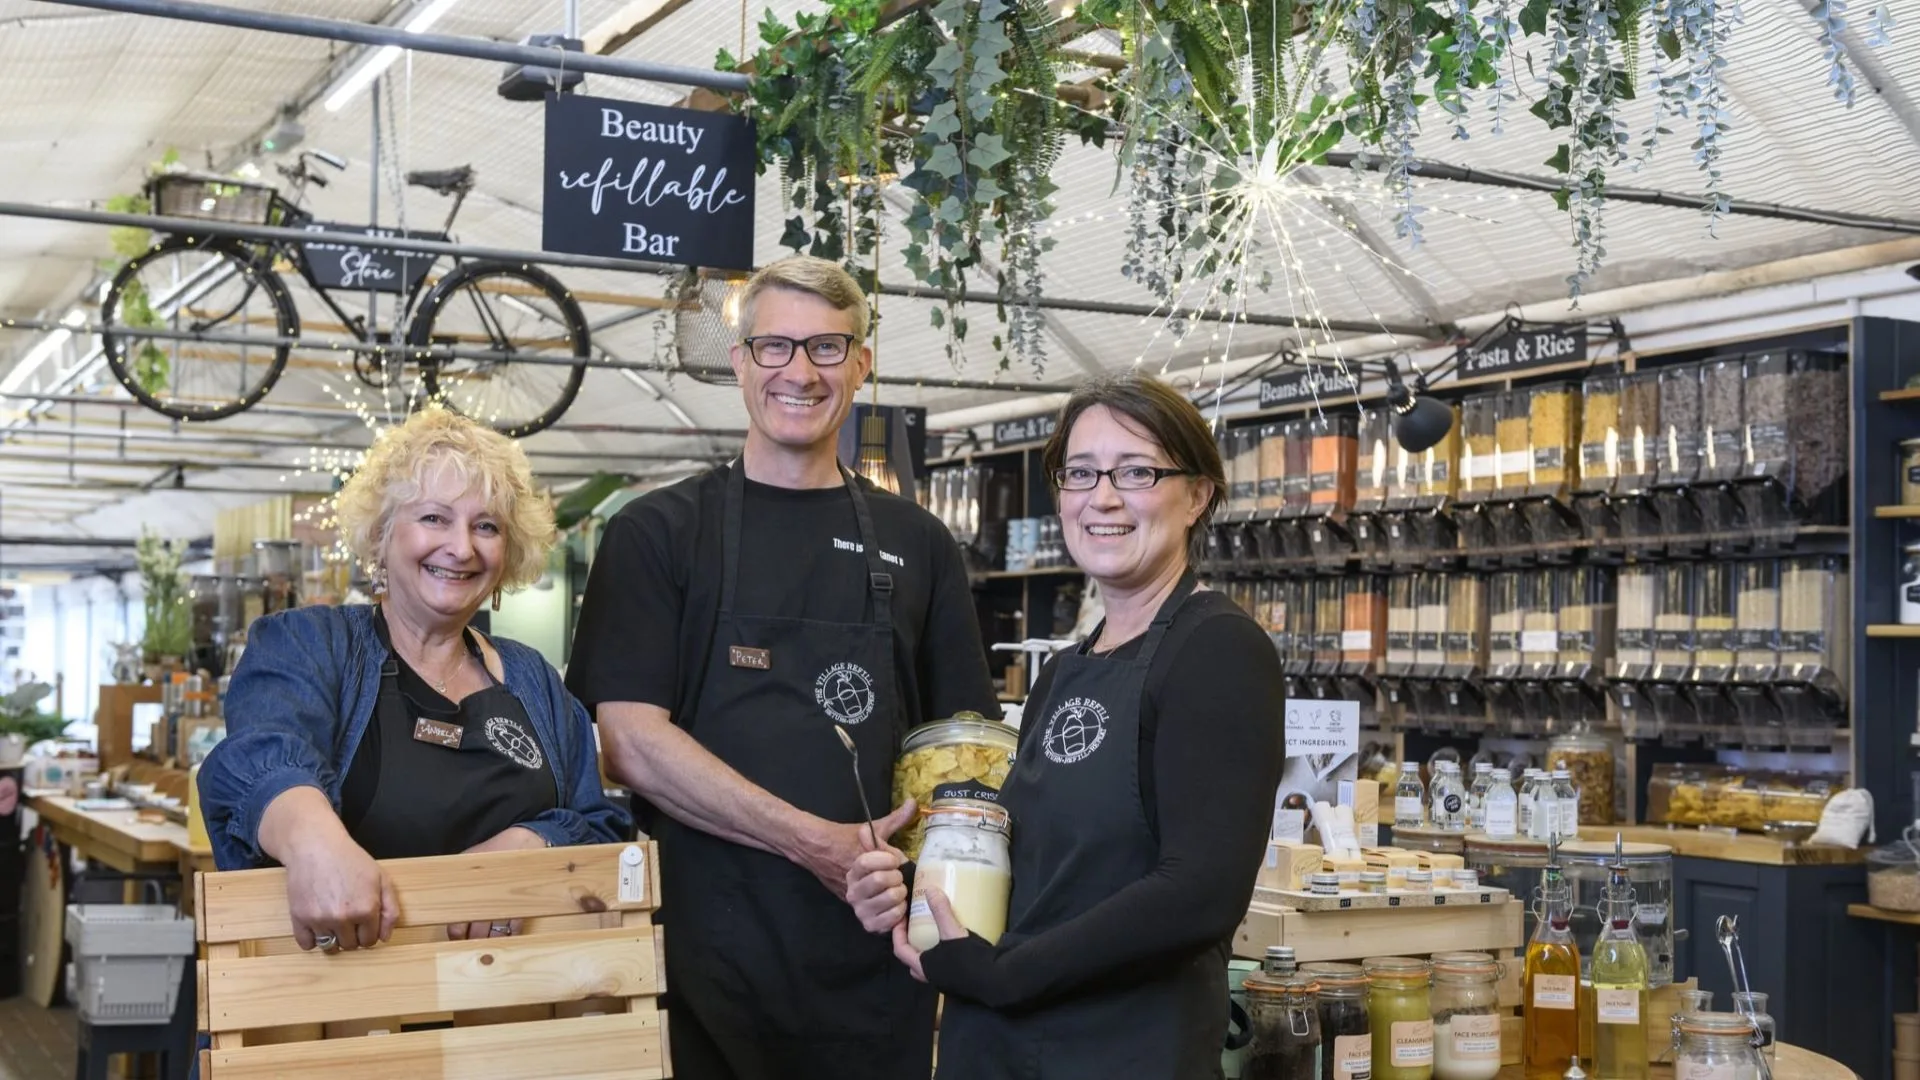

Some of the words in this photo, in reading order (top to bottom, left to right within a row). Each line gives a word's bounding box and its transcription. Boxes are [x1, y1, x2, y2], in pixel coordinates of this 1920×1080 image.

[601, 108, 704, 154] Beauty
[559, 157, 747, 215] refillable
[622, 222, 680, 257] Bar
[340, 251, 396, 287] Store
[1465, 347, 1510, 371] Pasta
[1514, 337, 1531, 363] &
[1535, 333, 1576, 360] Rice
[1261, 382, 1299, 403] Beans
[1299, 374, 1310, 397] &
[833, 537, 855, 551] There
[855, 543, 864, 553] is
[815, 662, 846, 686] VILLAGE
[846, 662, 874, 687] REFILL
[815, 688, 824, 705] THE
[1083, 697, 1110, 723] REFILL
[944, 789, 971, 798] JUST
